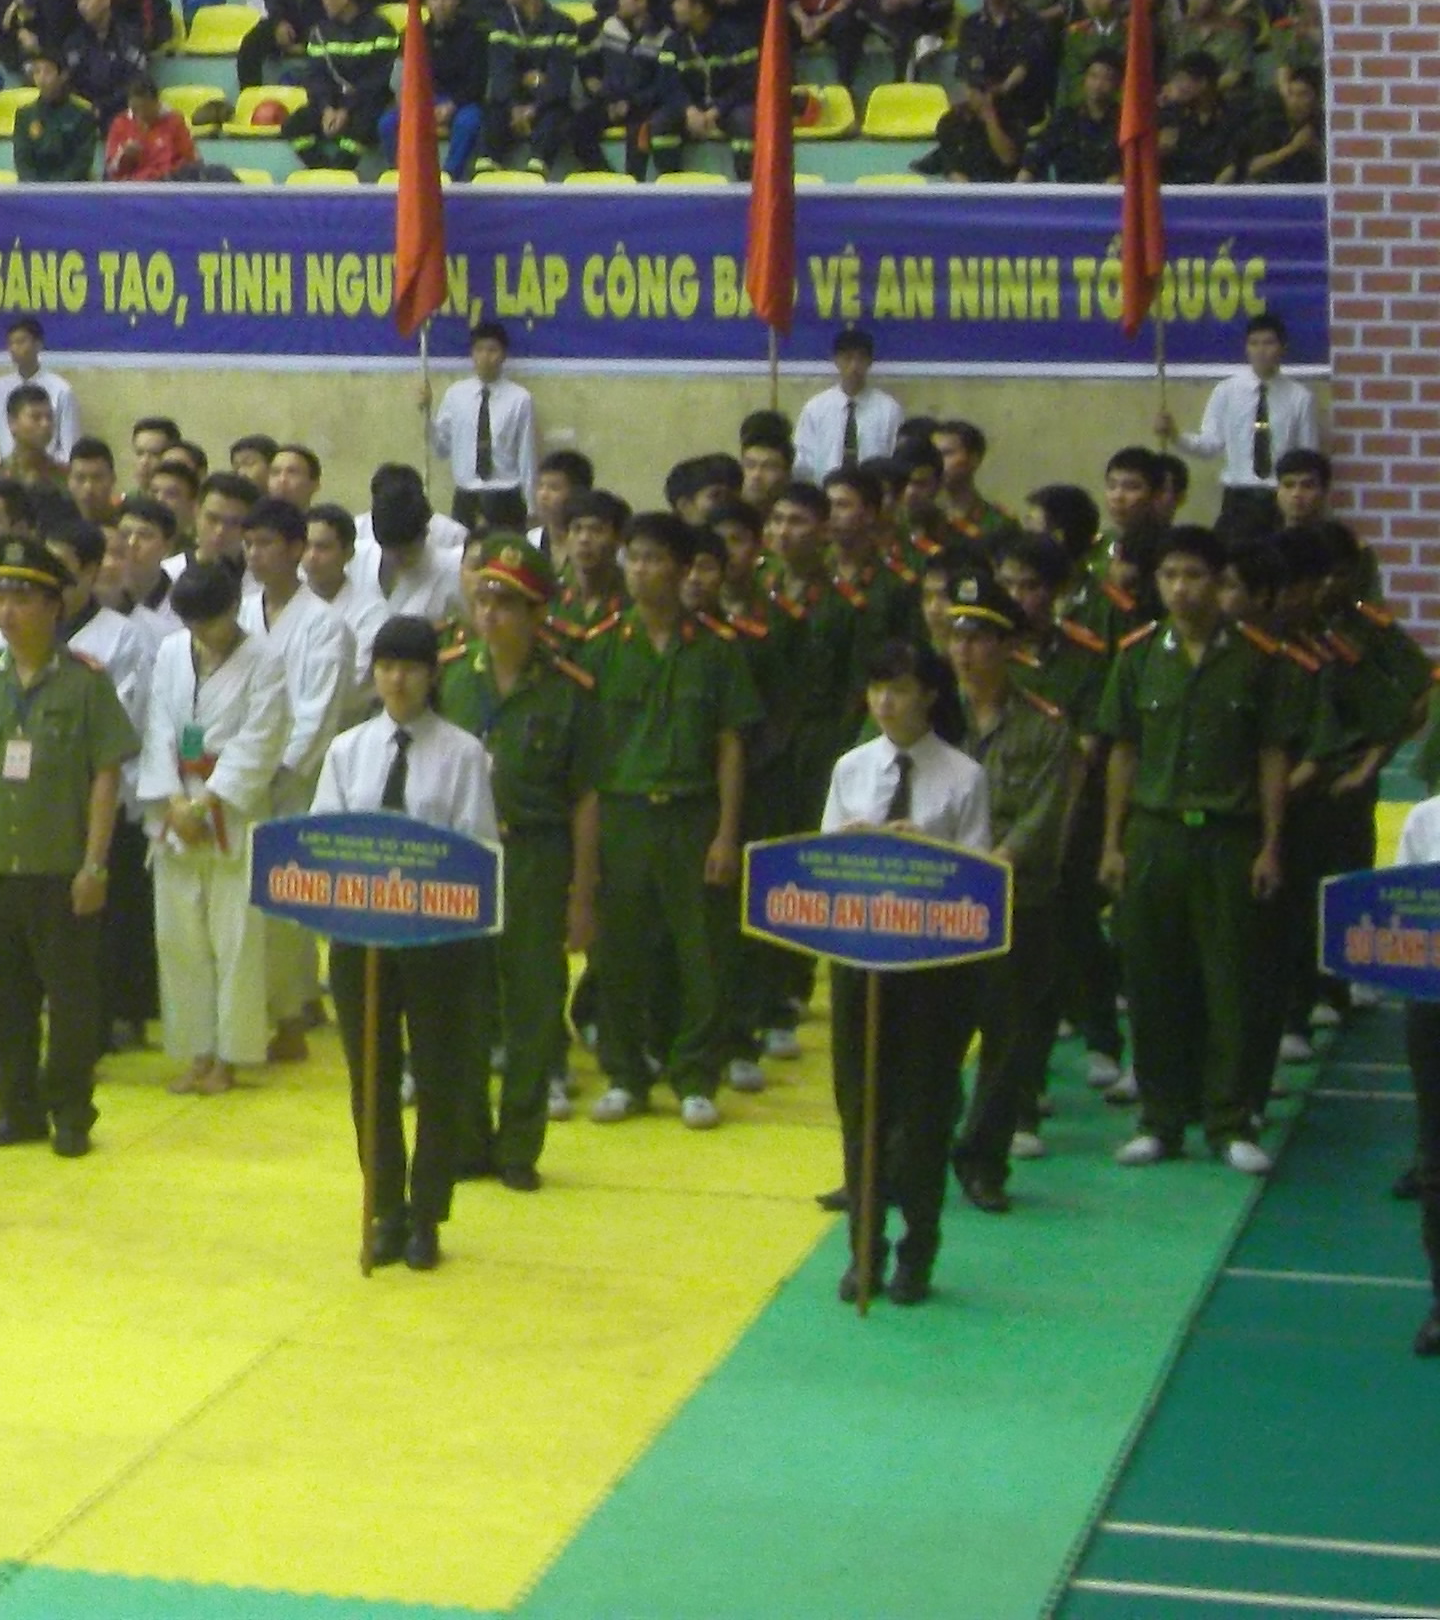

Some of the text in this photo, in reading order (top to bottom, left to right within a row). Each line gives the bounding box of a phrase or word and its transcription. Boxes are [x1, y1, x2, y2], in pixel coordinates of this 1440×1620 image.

[98, 249, 188, 328] TẠO,
[197, 237, 293, 315] TÌNH
[495, 240, 570, 331] LẬP
[581, 240, 700, 320] CÔNG
[807, 242, 861, 331] VỆ
[873, 254, 935, 321] AN
[948, 254, 1060, 322] NINH
[269, 860, 332, 908] CÔNG
[334, 872, 368, 910] AN
[420, 881, 480, 922] NINH
[766, 880, 830, 929] CÔNG
[832, 892, 867, 931] AN
